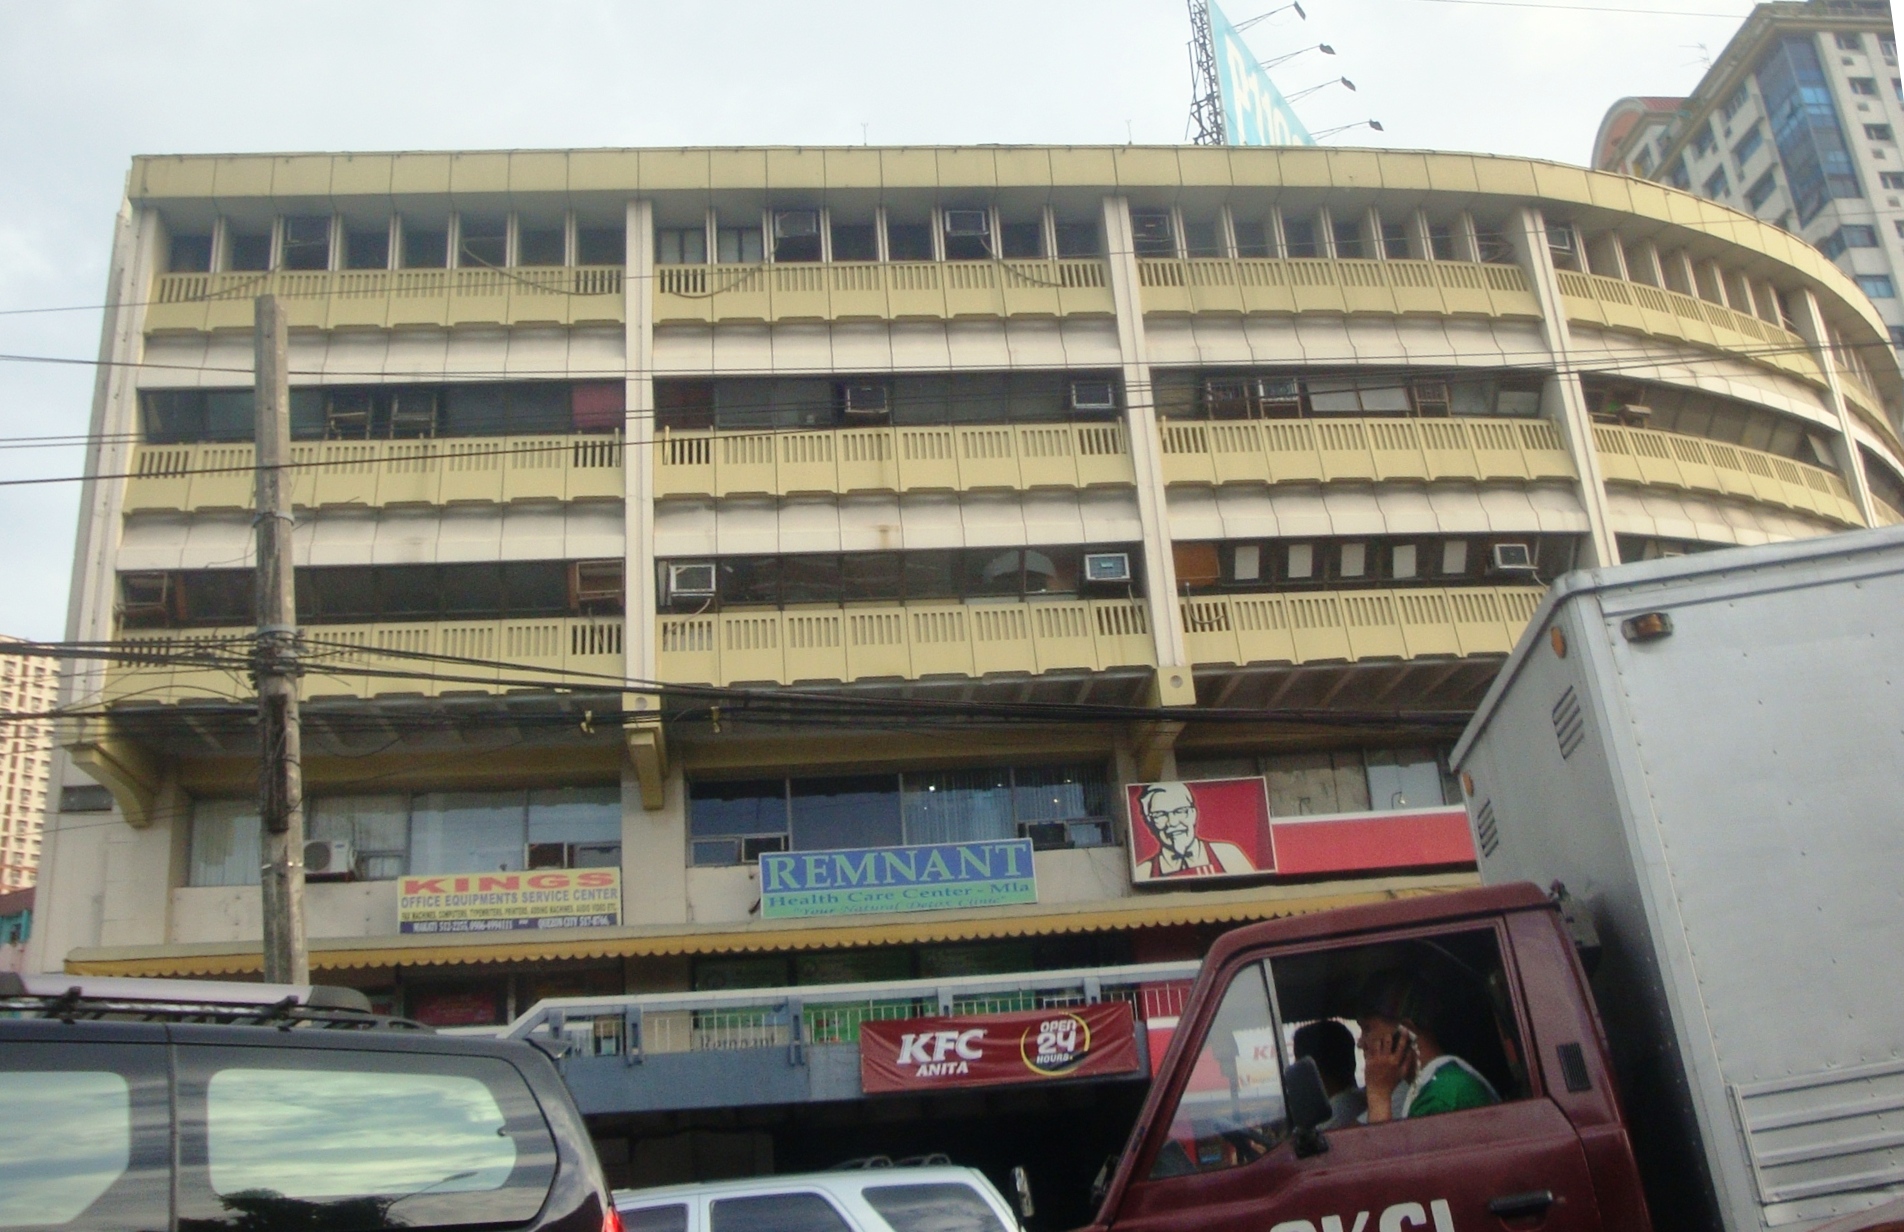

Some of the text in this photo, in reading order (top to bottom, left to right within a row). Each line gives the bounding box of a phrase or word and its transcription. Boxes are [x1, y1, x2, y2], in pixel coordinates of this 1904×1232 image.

[765, 843, 1027, 891] REMNANT
[404, 872, 615, 895] KINGS
[401, 888, 618, 909] OFFICE EQUIPMENTS SERVICE CENTER
[769, 893, 839, 908] Health
[847, 890, 895, 903] Care
[902, 886, 973, 899] Center
[896, 1029, 1077, 1064] KFC 24
[915, 1062, 969, 1077] ANITA
